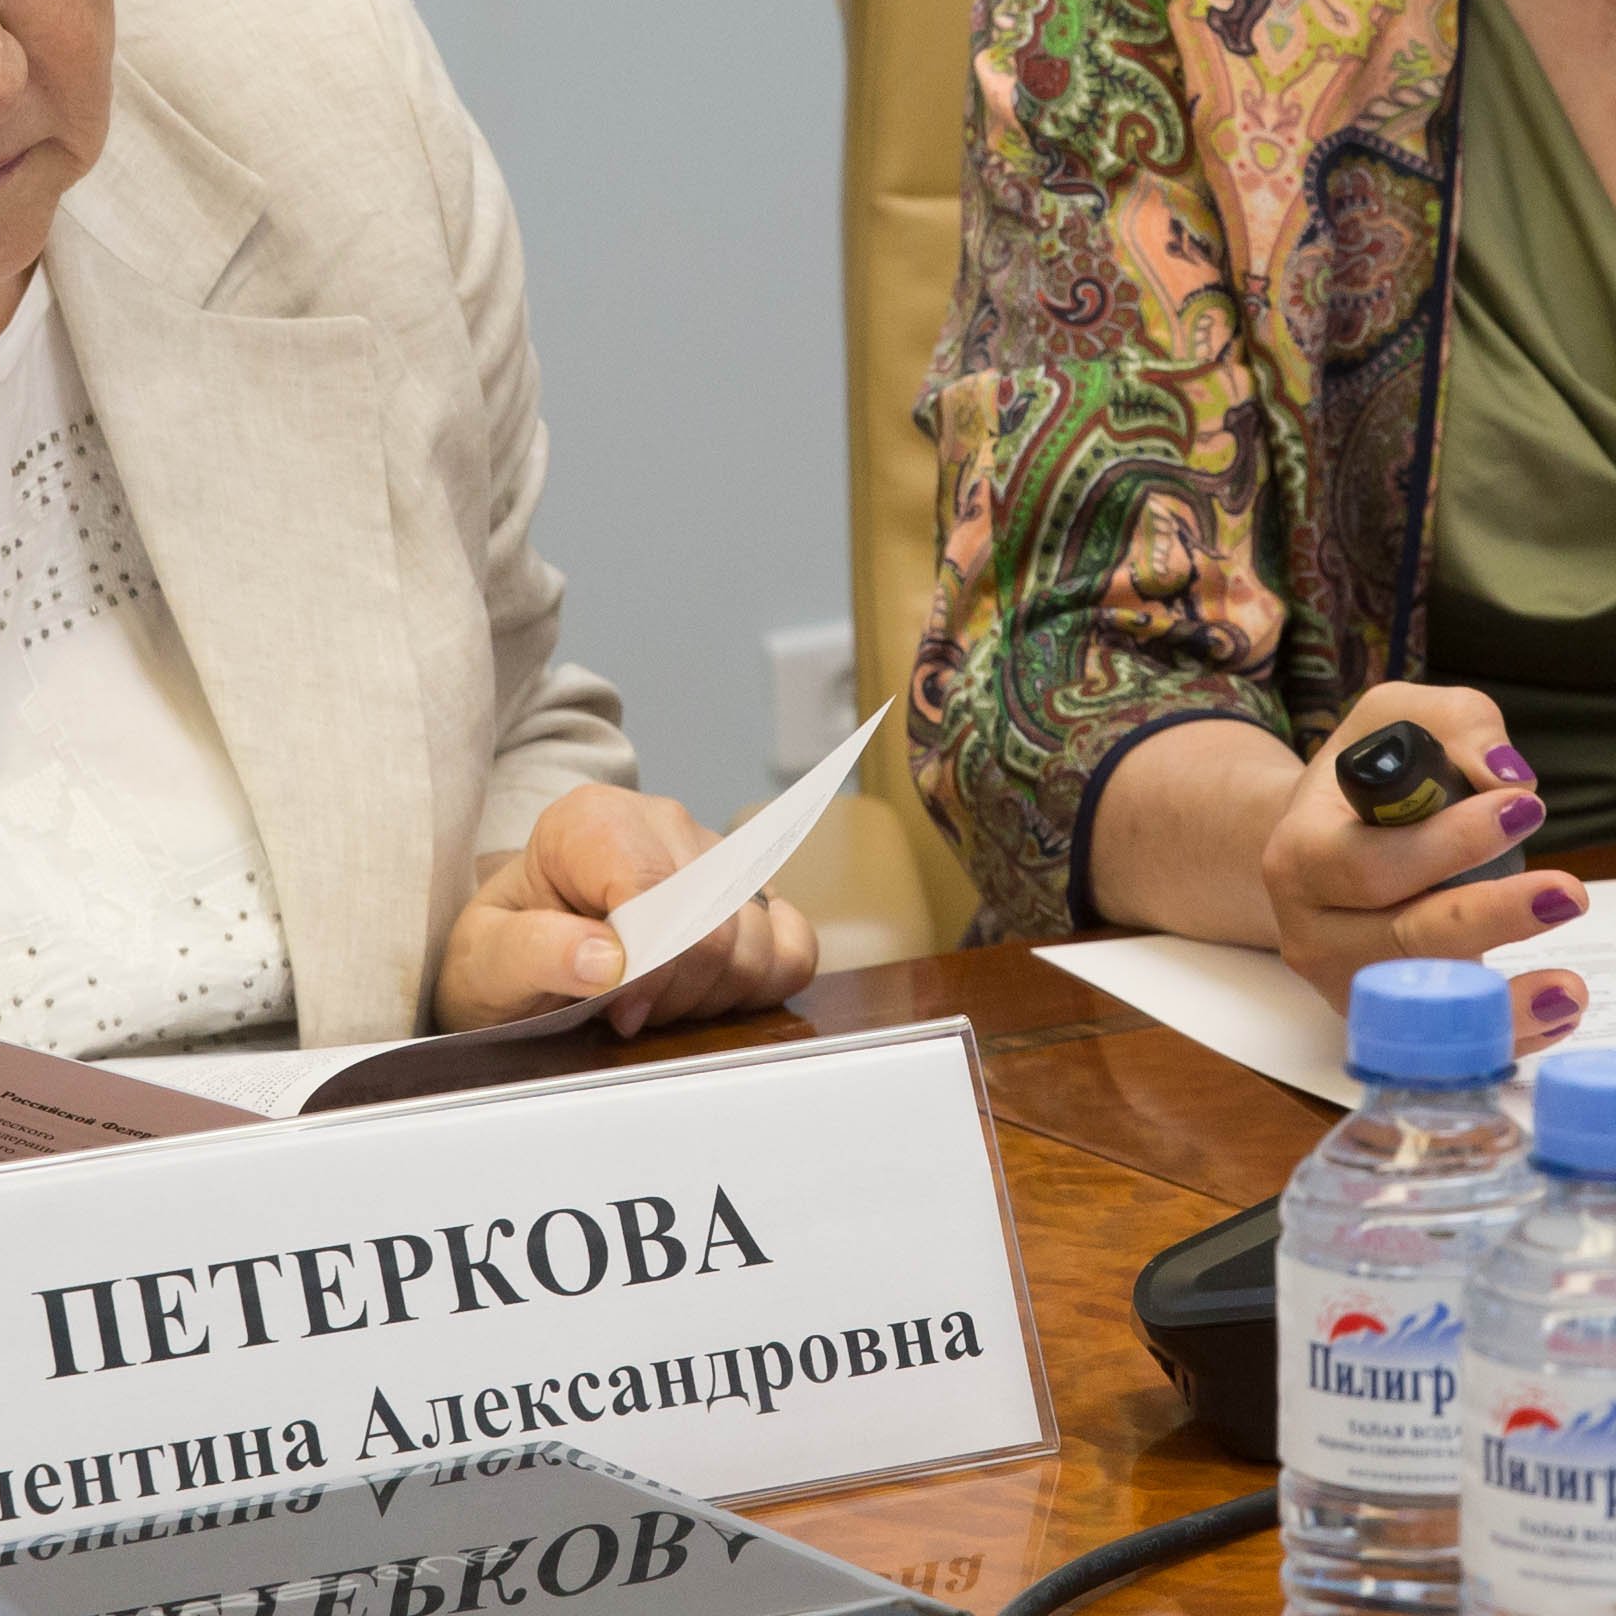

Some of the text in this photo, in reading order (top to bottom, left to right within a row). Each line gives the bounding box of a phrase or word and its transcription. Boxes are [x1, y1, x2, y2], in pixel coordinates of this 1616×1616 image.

[0, 1090, 97, 1126] Российской
[101, 1121, 159, 1140] Федер
[32, 1181, 773, 1381] ПЕТЕРКОВА
[353, 1308, 984, 1465] Александровна
[1308, 1341, 1457, 1417] Пилигр
